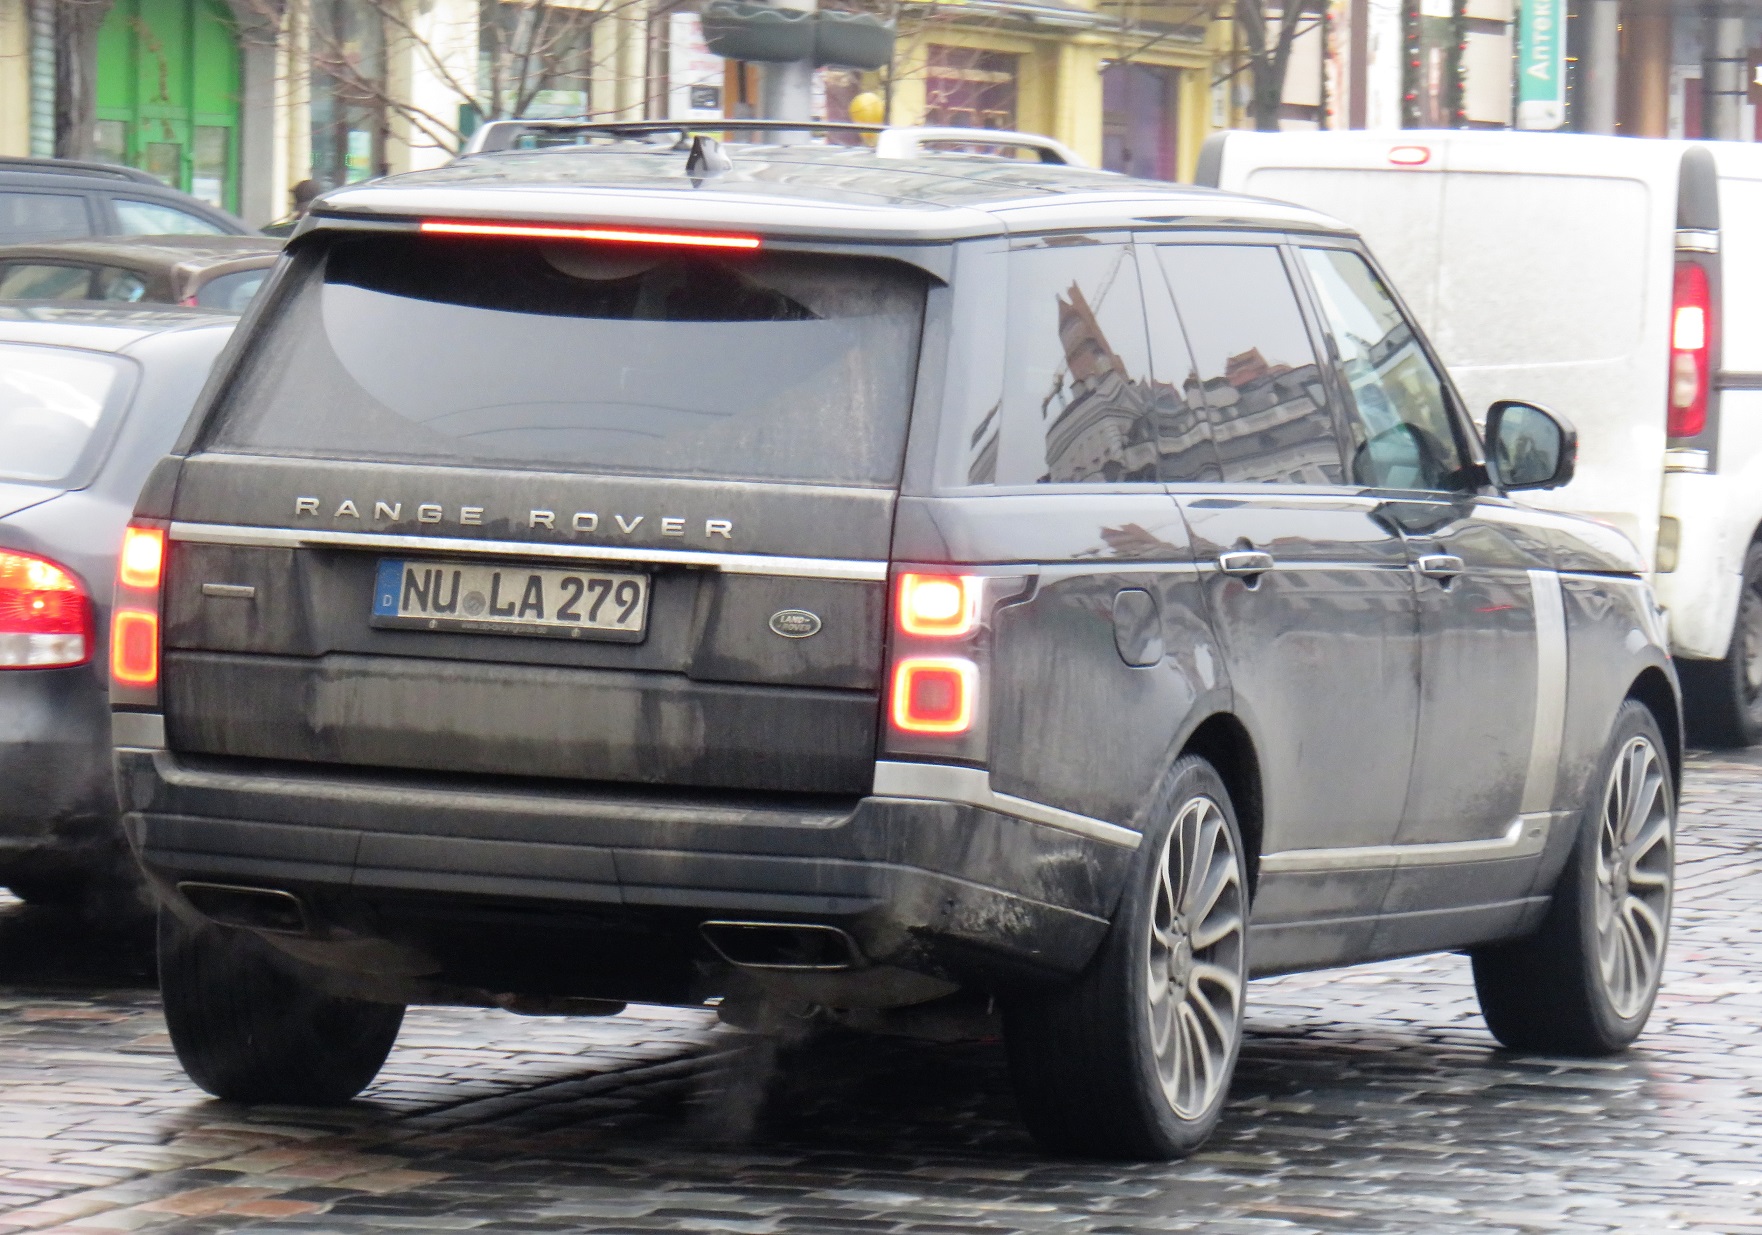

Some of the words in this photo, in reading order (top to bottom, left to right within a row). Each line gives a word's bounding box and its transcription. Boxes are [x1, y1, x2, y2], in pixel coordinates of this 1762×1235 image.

[1526, 0, 1552, 81] Аптек
[295, 496, 484, 526] RANGE
[529, 510, 734, 539] ROVER
[382, 594, 393, 607] D
[402, 568, 462, 614] NU
[489, 572, 545, 620] LA
[556, 576, 641, 624] 279
